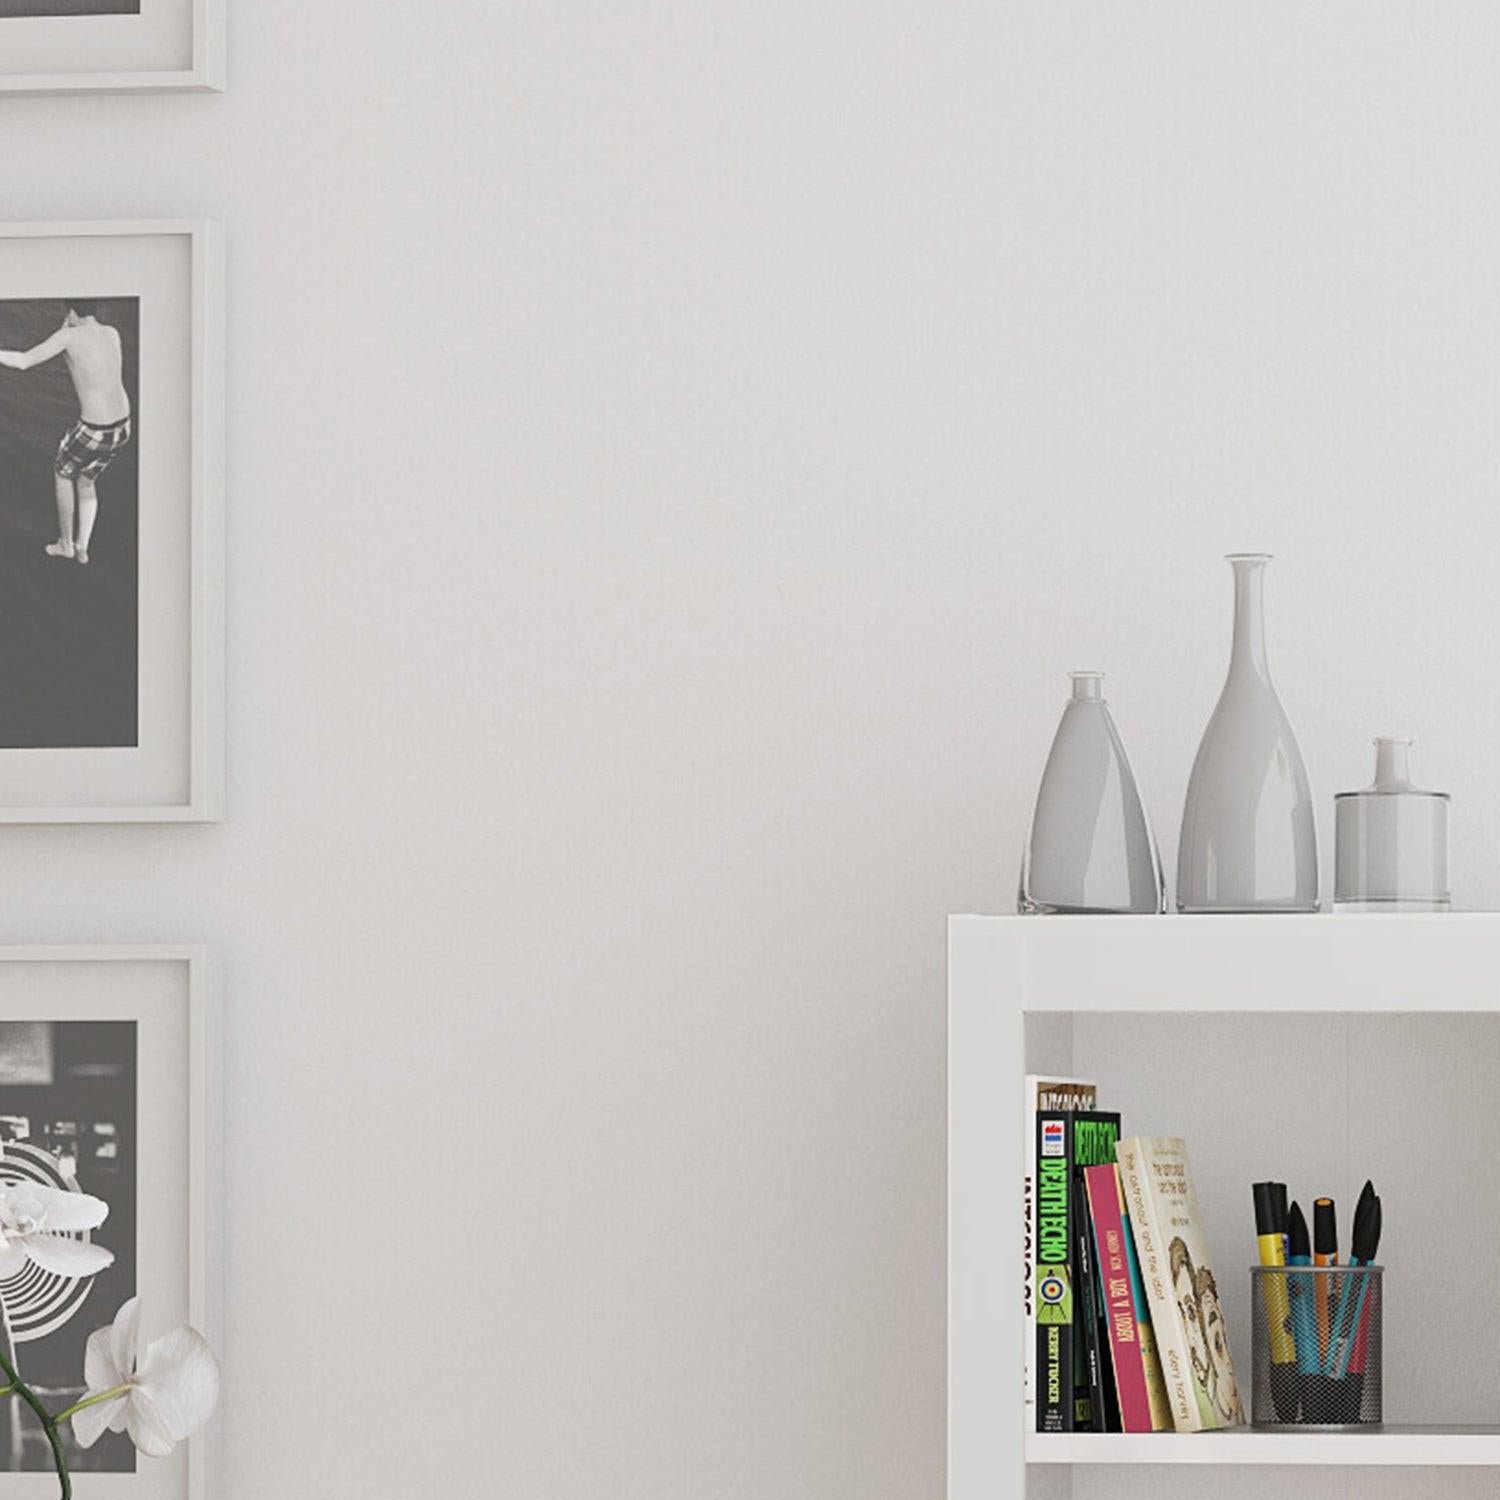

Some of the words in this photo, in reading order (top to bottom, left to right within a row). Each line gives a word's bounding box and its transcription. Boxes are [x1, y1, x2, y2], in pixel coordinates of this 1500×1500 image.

[1039, 1158, 1068, 1214] DEATH
[1039, 1216, 1068, 1263] ECHO
[1142, 1231, 1155, 1253] and
[1109, 1278, 1129, 1299] BOY
[1112, 1299, 1131, 1308] A
[1114, 1312, 1136, 1343] ABOUT
[1048, 1363, 1060, 1404] TUCKER
